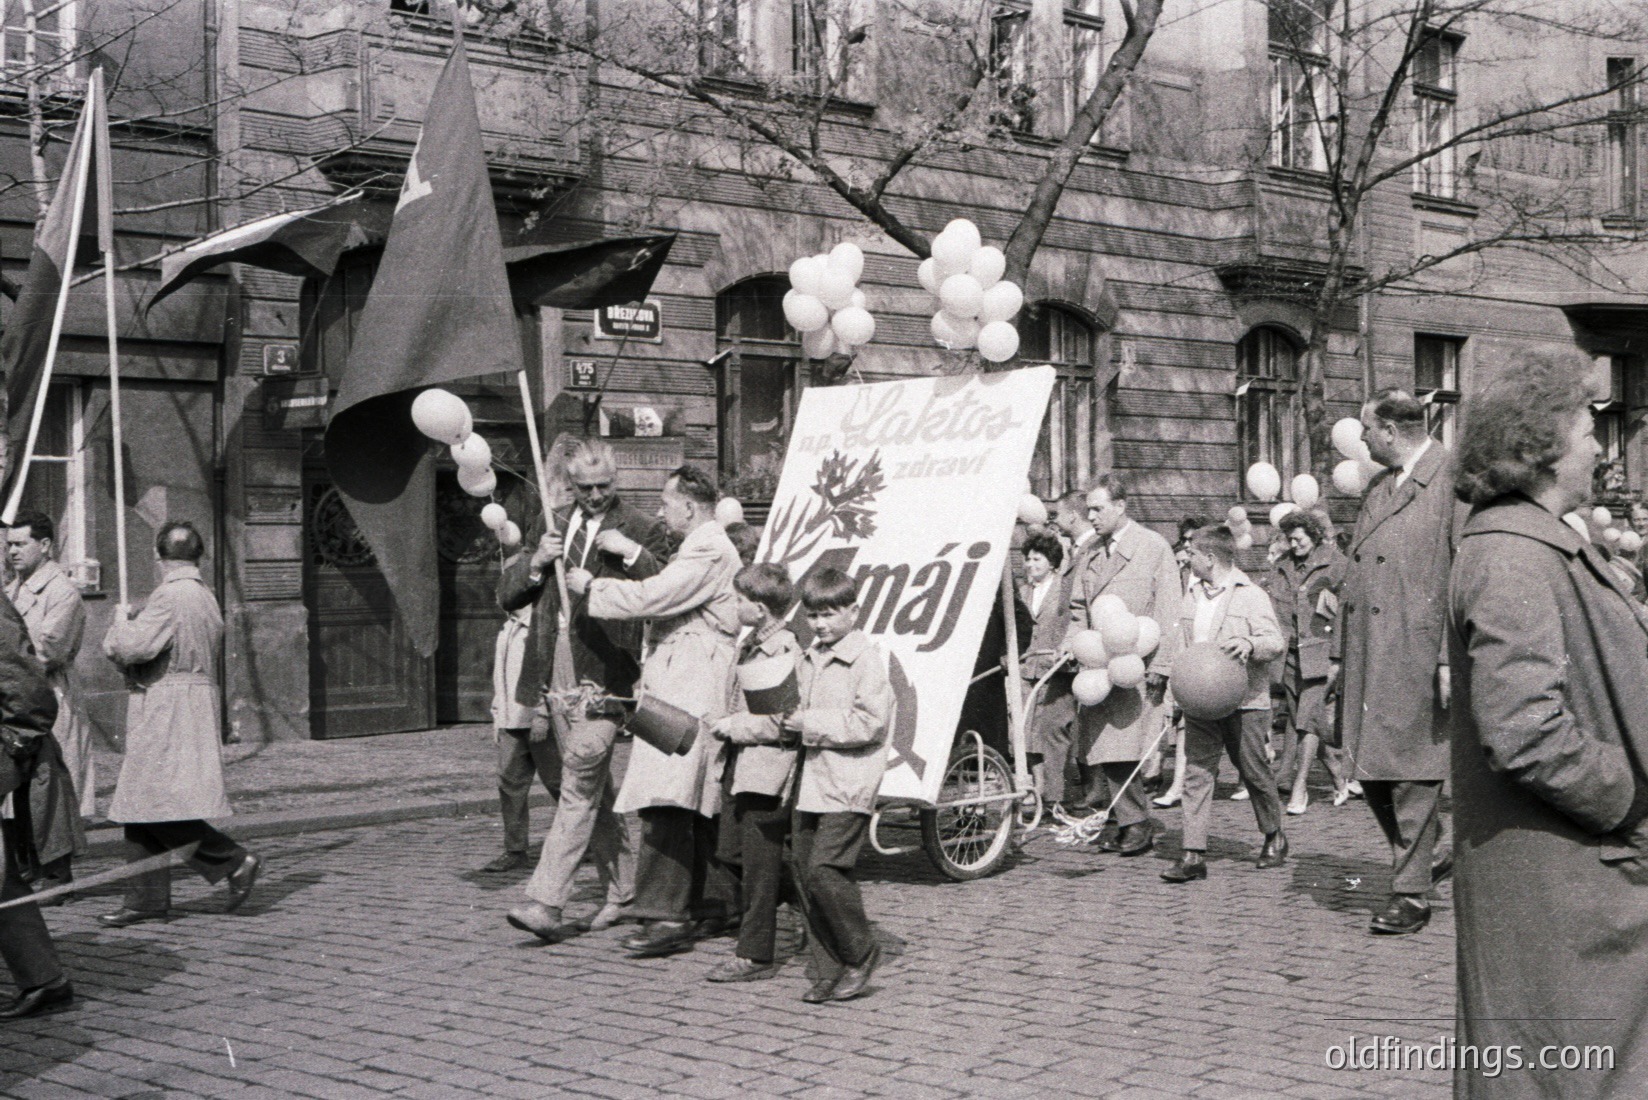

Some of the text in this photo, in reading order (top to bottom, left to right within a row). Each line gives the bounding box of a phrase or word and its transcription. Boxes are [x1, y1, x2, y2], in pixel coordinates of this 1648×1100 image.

[276, 350, 286, 364] 3
[576, 361, 595, 375] 475
[891, 446, 994, 481] zdraví
[854, 540, 992, 653] máj
